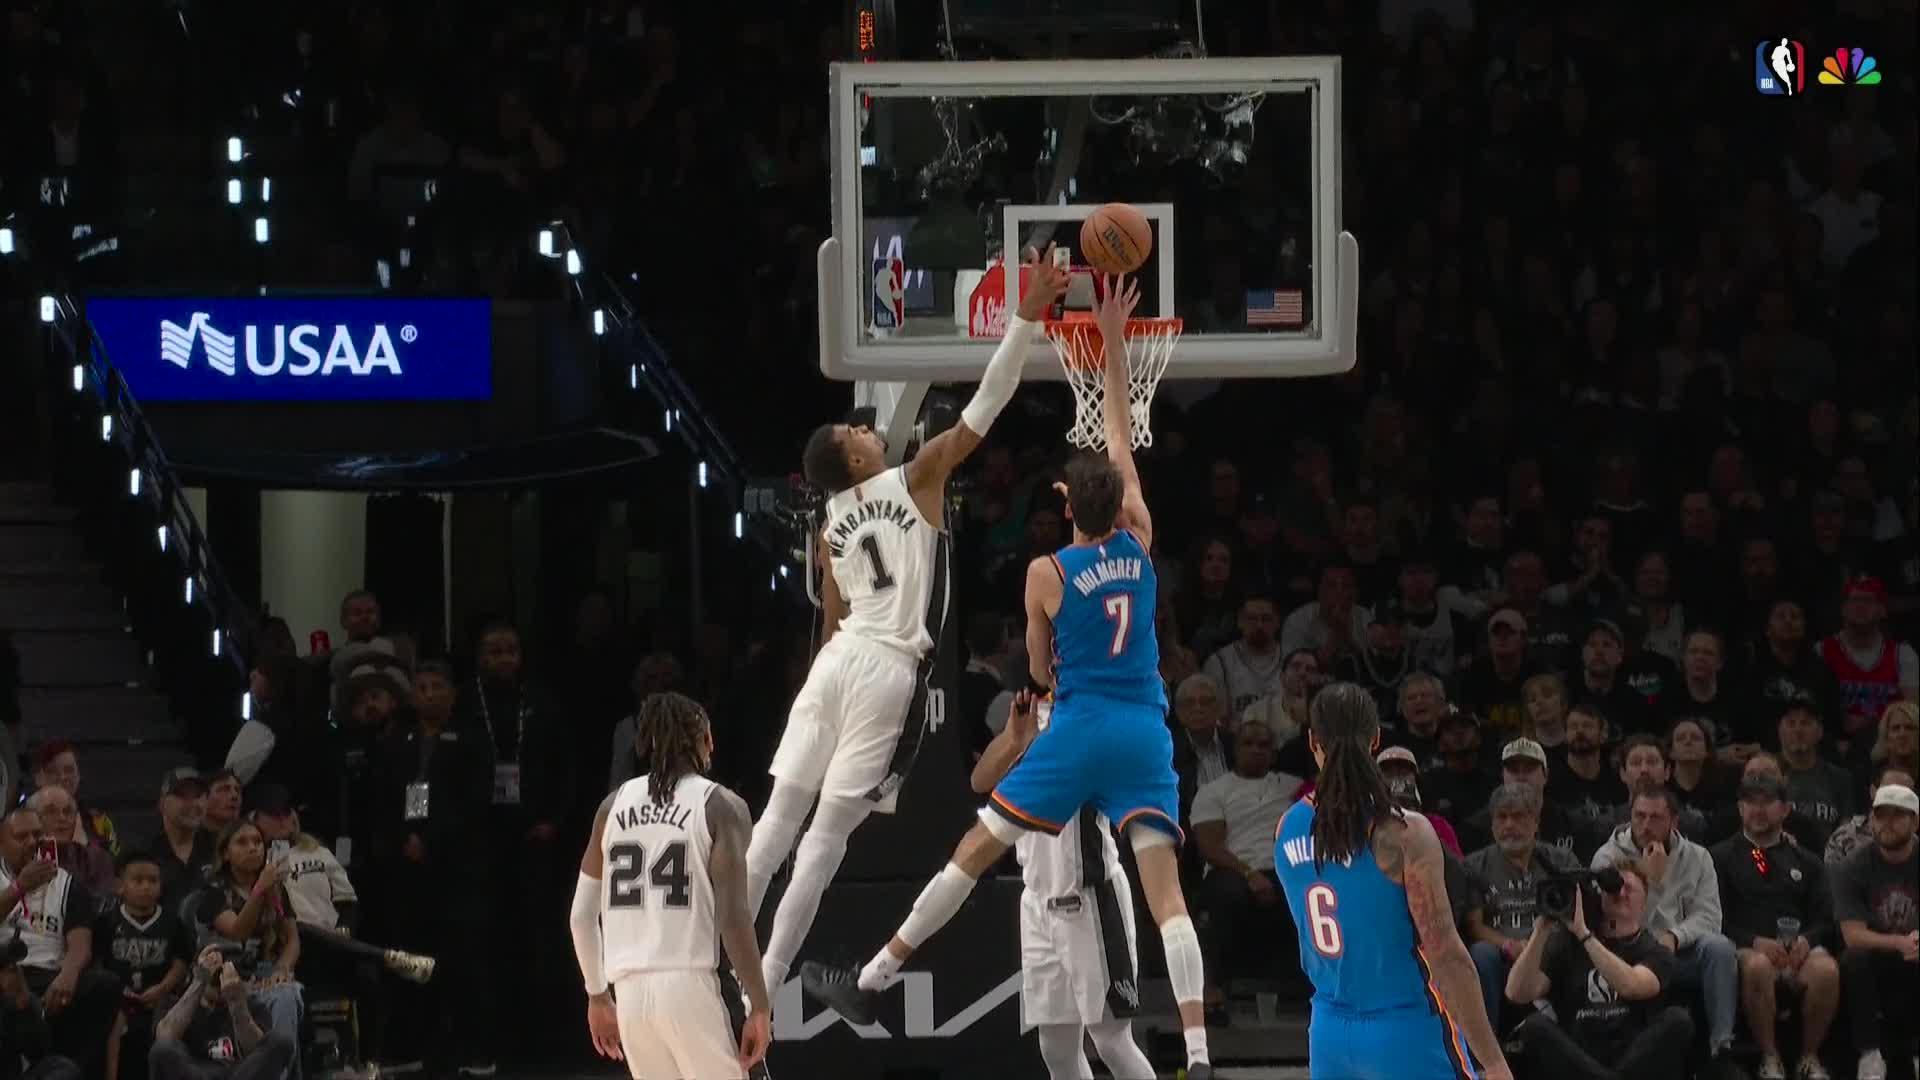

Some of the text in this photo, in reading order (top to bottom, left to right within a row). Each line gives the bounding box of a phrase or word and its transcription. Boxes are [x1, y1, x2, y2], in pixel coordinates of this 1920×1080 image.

[861, 532, 895, 592] 1
[1072, 556, 1142, 598] HOLMGREN
[1102, 591, 1132, 657] 7
[615, 802, 692, 831] VASSELL
[608, 841, 694, 910] 24
[1305, 882, 1346, 959] 6
